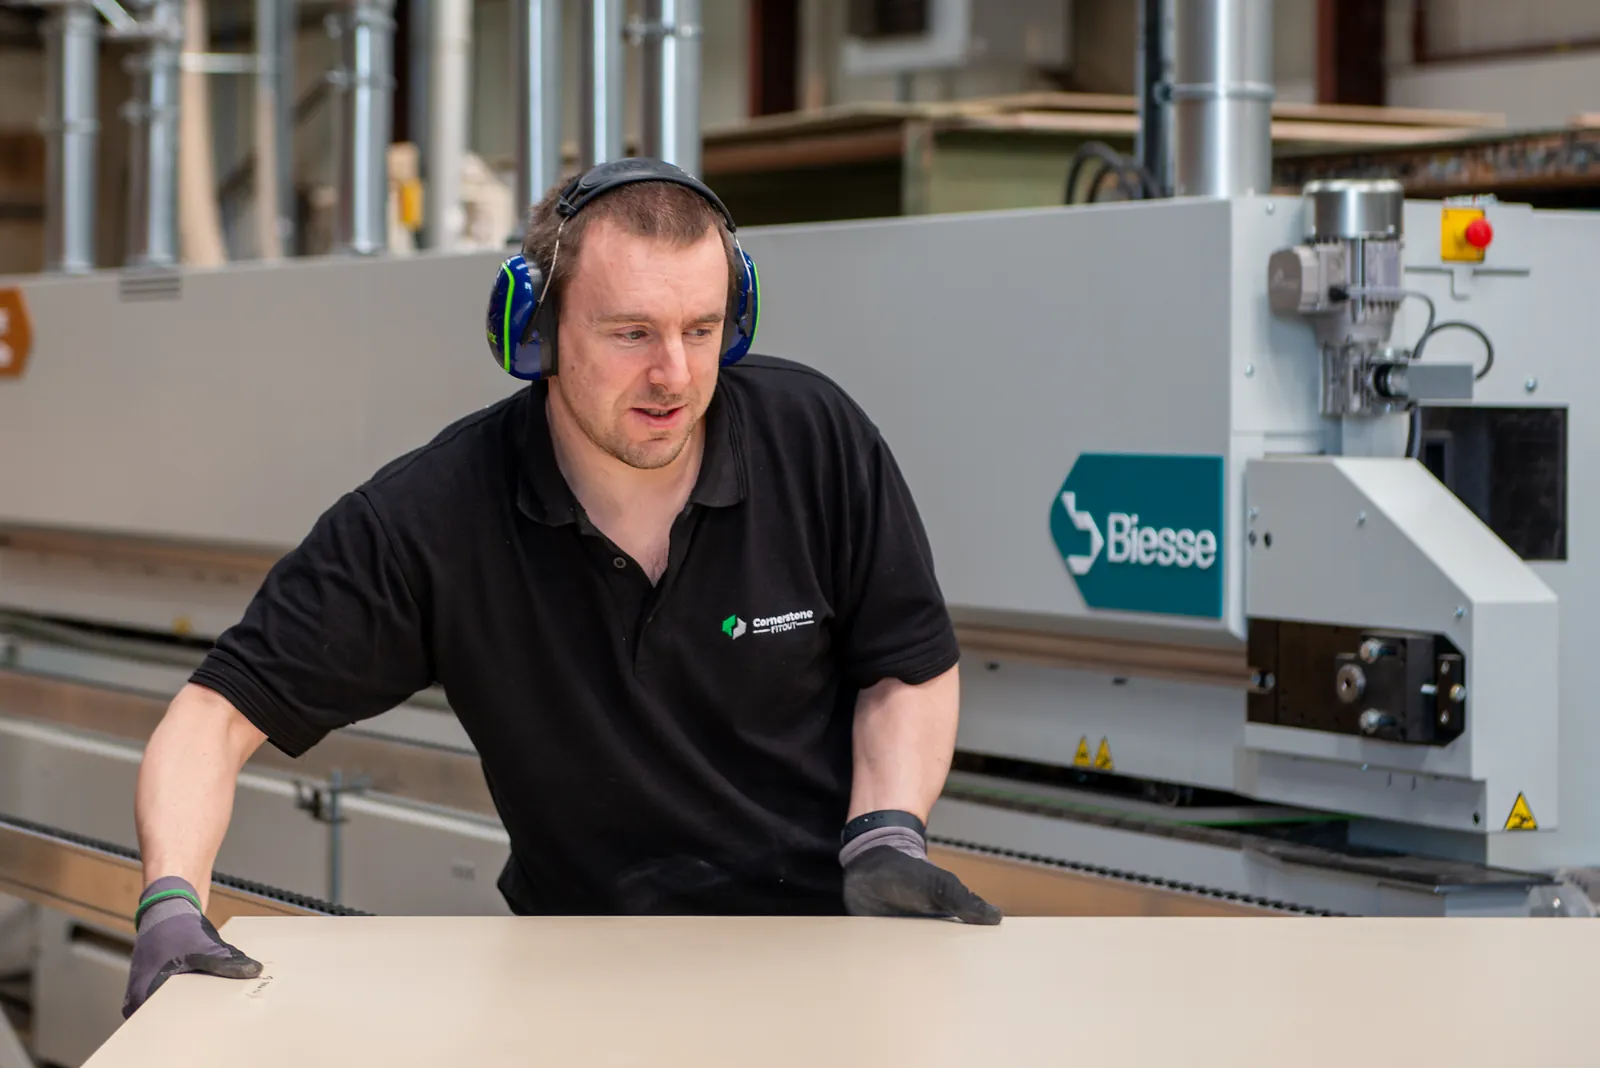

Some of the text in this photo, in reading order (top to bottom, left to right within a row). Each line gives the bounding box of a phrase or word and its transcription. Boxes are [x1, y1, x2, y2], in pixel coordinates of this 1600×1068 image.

[1107, 512, 1217, 569] Biesse
[753, 610, 813, 627] Cornerstone
[770, 621, 797, 633] FITOUT
